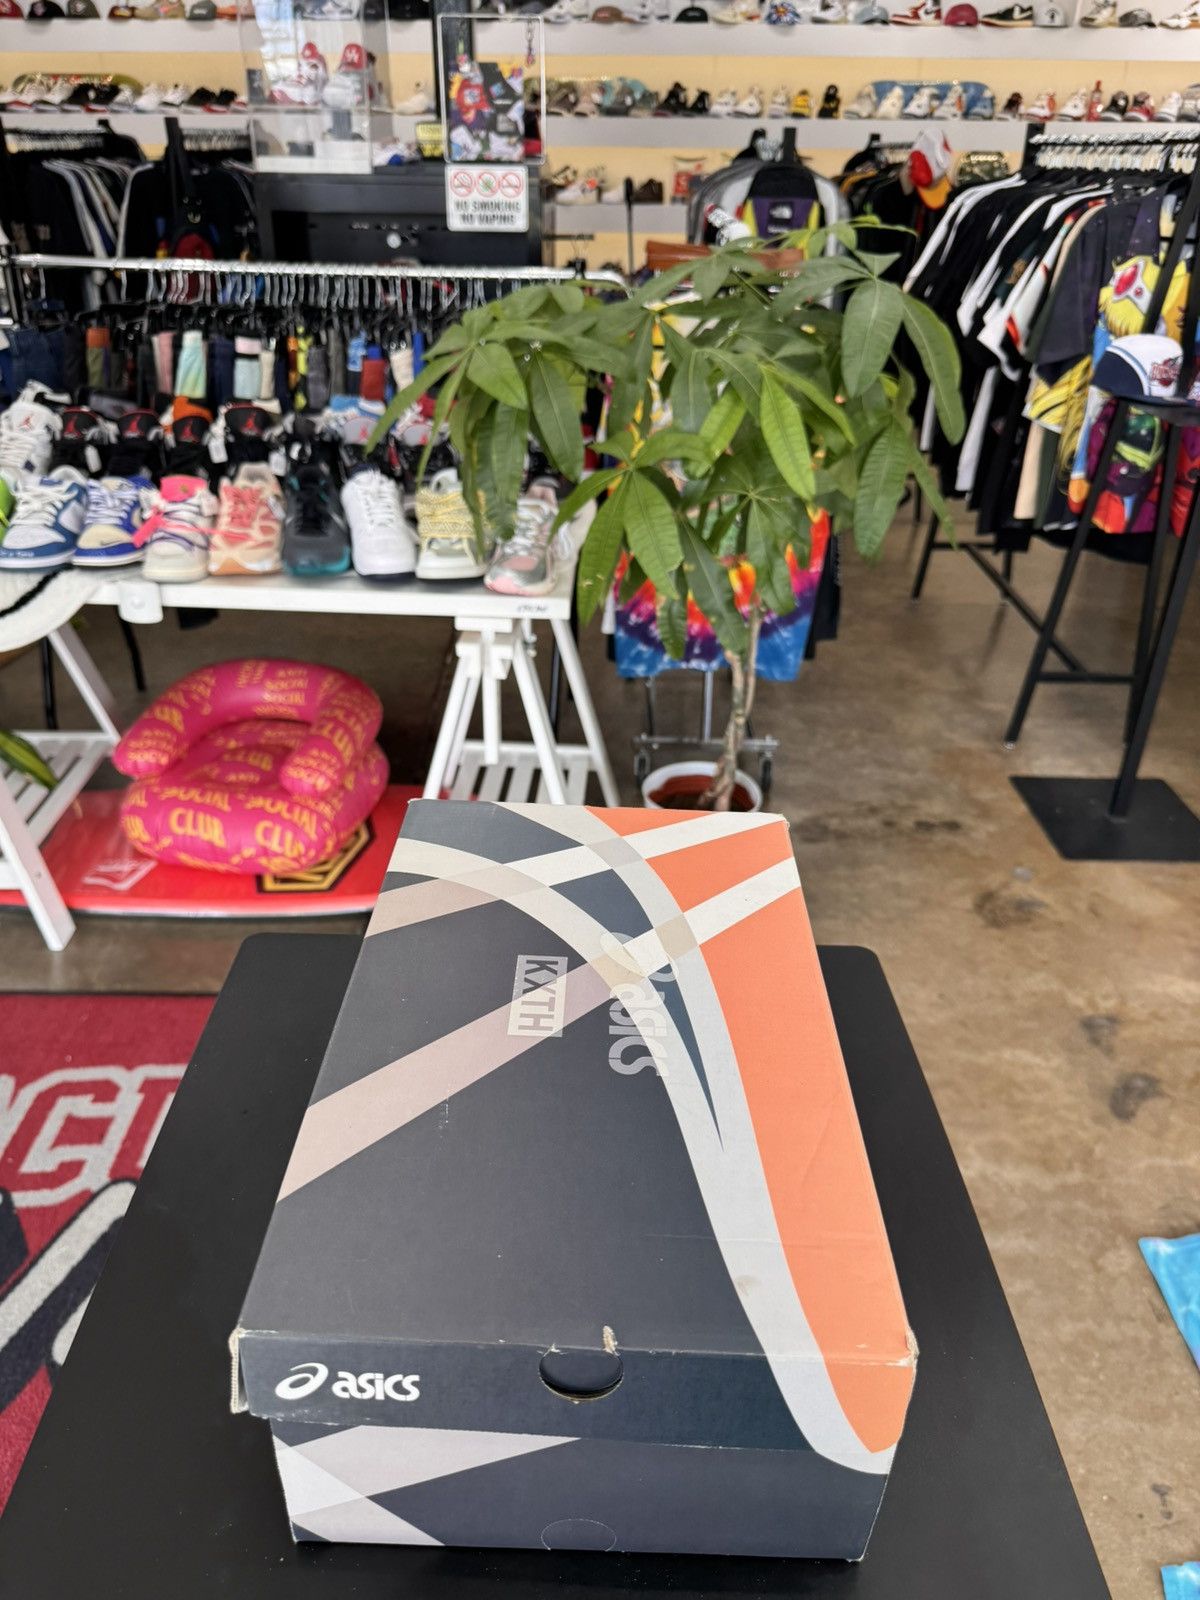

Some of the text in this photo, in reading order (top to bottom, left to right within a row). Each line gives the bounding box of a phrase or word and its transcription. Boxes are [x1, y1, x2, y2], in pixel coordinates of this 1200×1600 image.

[455, 200, 521, 212] NO SMOKING
[461, 214, 515, 225] NO VAPING
[331, 1370, 421, 1402] asics
